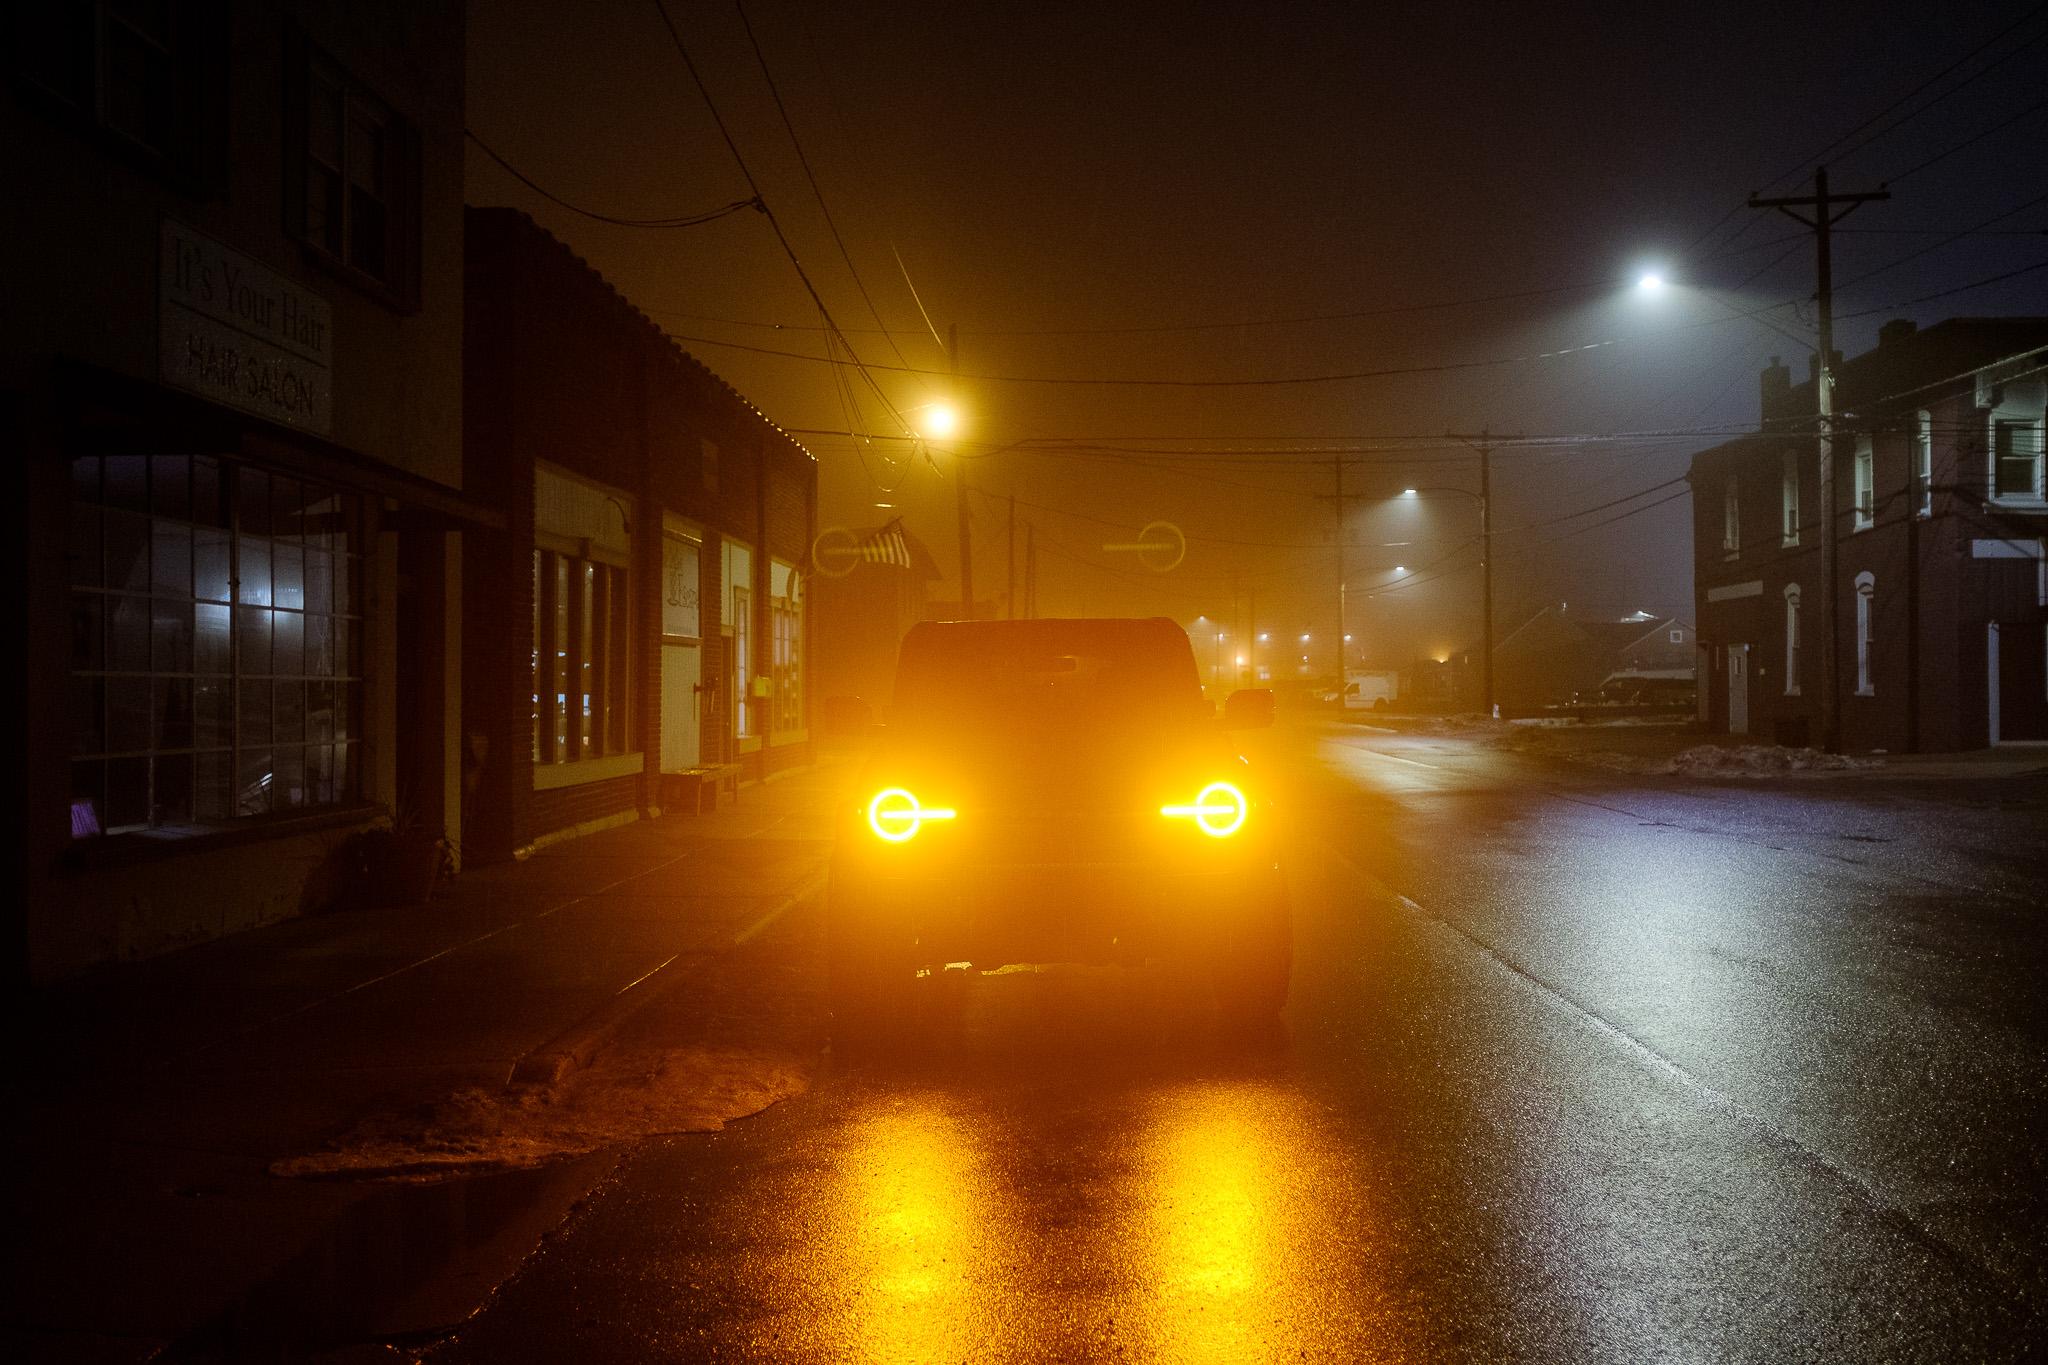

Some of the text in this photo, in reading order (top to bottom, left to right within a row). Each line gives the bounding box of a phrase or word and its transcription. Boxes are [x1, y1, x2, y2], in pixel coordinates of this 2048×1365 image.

[174, 238, 325, 352] It's Your Hair
[187, 333, 314, 416] HAIR SALON
